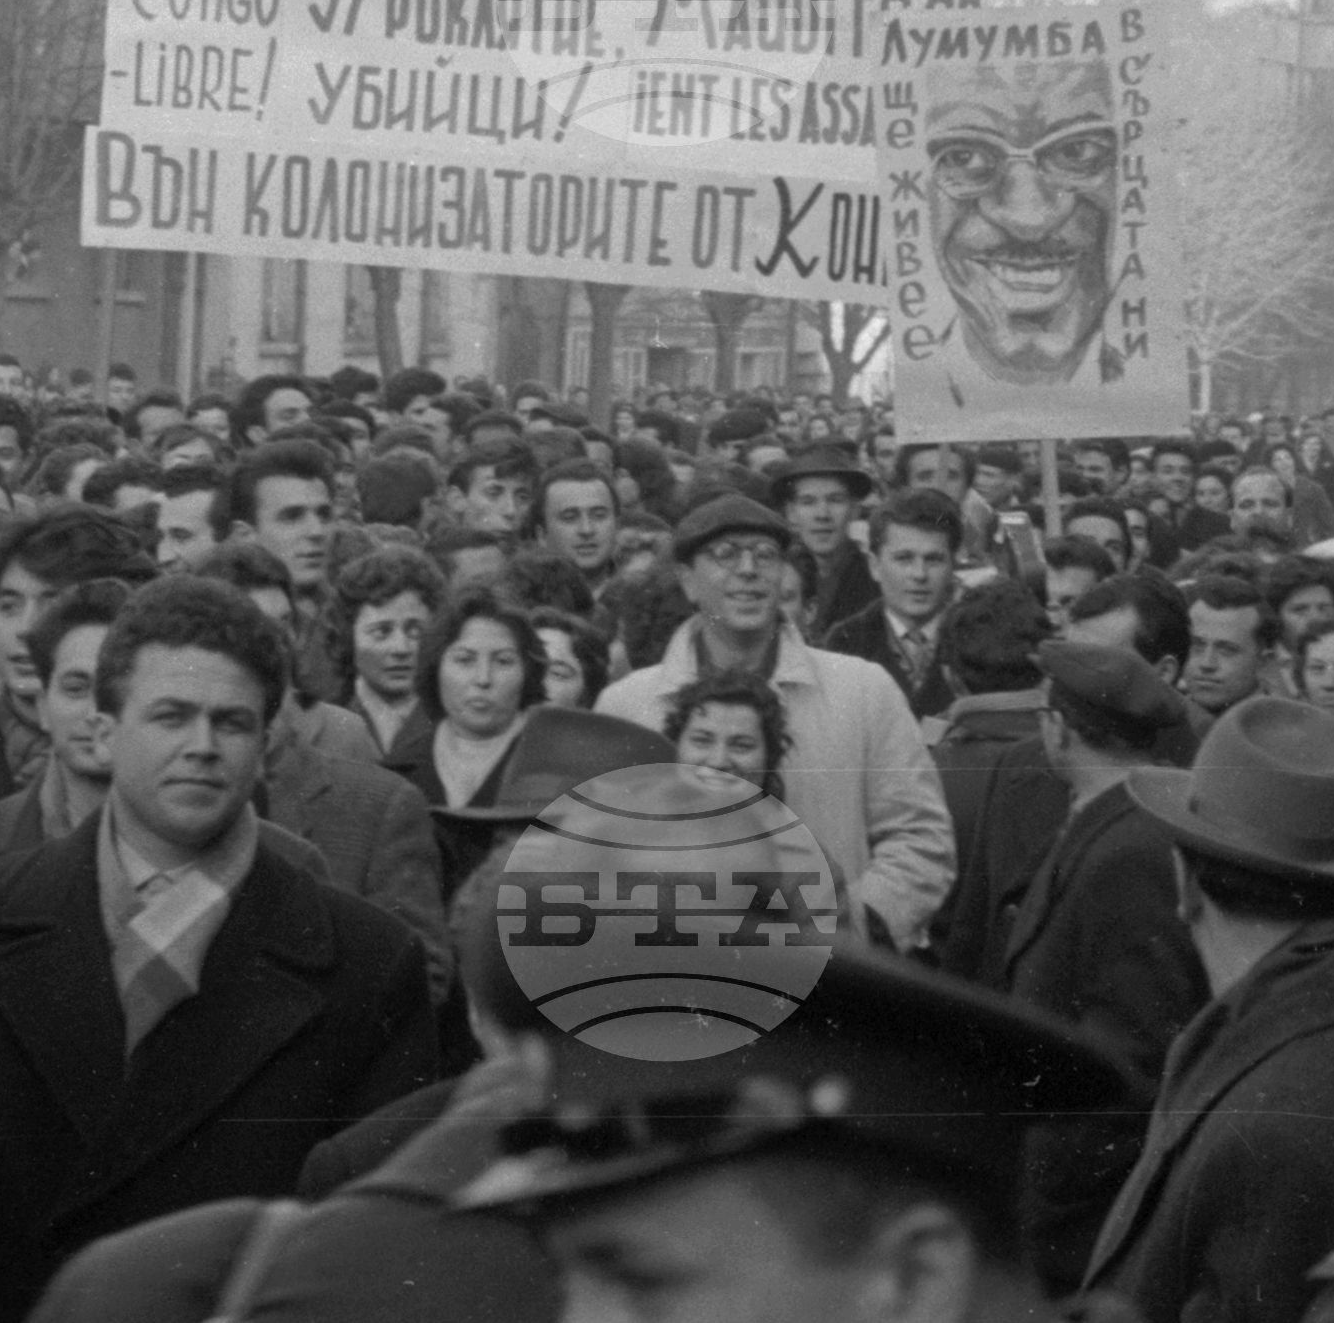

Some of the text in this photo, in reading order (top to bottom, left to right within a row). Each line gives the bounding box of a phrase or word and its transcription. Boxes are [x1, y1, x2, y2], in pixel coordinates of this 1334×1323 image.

[881, 18, 1105, 67] ЛУМУМБА
[307, 53, 594, 144] УБИЙЦИ!
[729, 76, 794, 142] LES
[95, 130, 887, 287] ВЪН КОЛОНИЗАТОРИТЕ ОТ КОН
[1121, 296, 1149, 359] НИ
